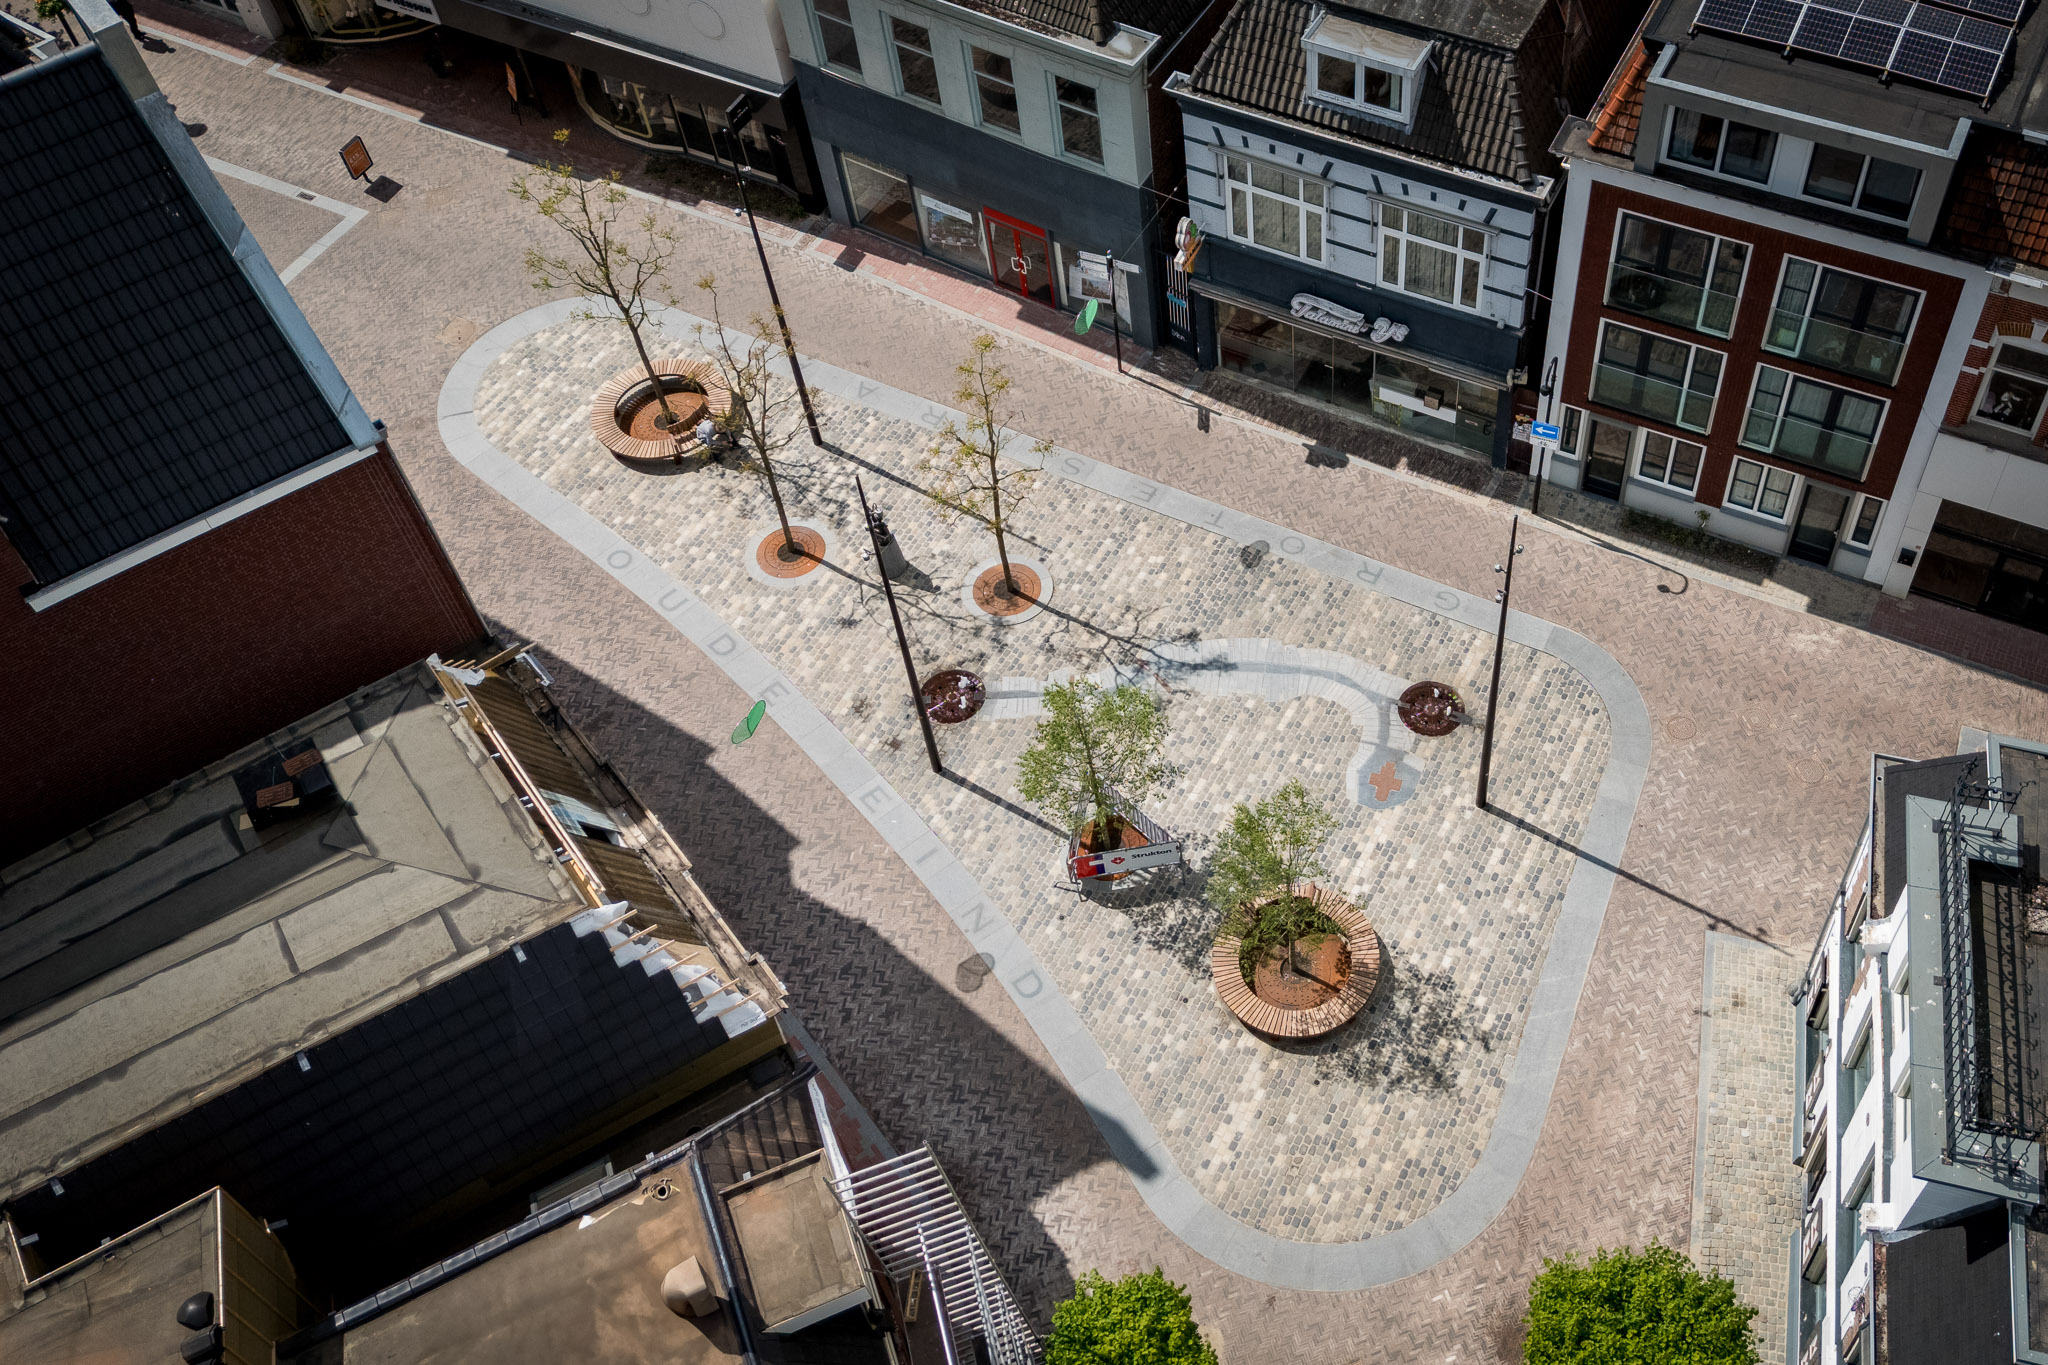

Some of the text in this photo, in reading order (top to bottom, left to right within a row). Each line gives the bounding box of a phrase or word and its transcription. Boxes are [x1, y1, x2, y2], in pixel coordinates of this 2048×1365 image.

[607, 550, 791, 708] OUDE
[859, 785, 1043, 999] EIND
[1132, 849, 1172, 859] Strukton
